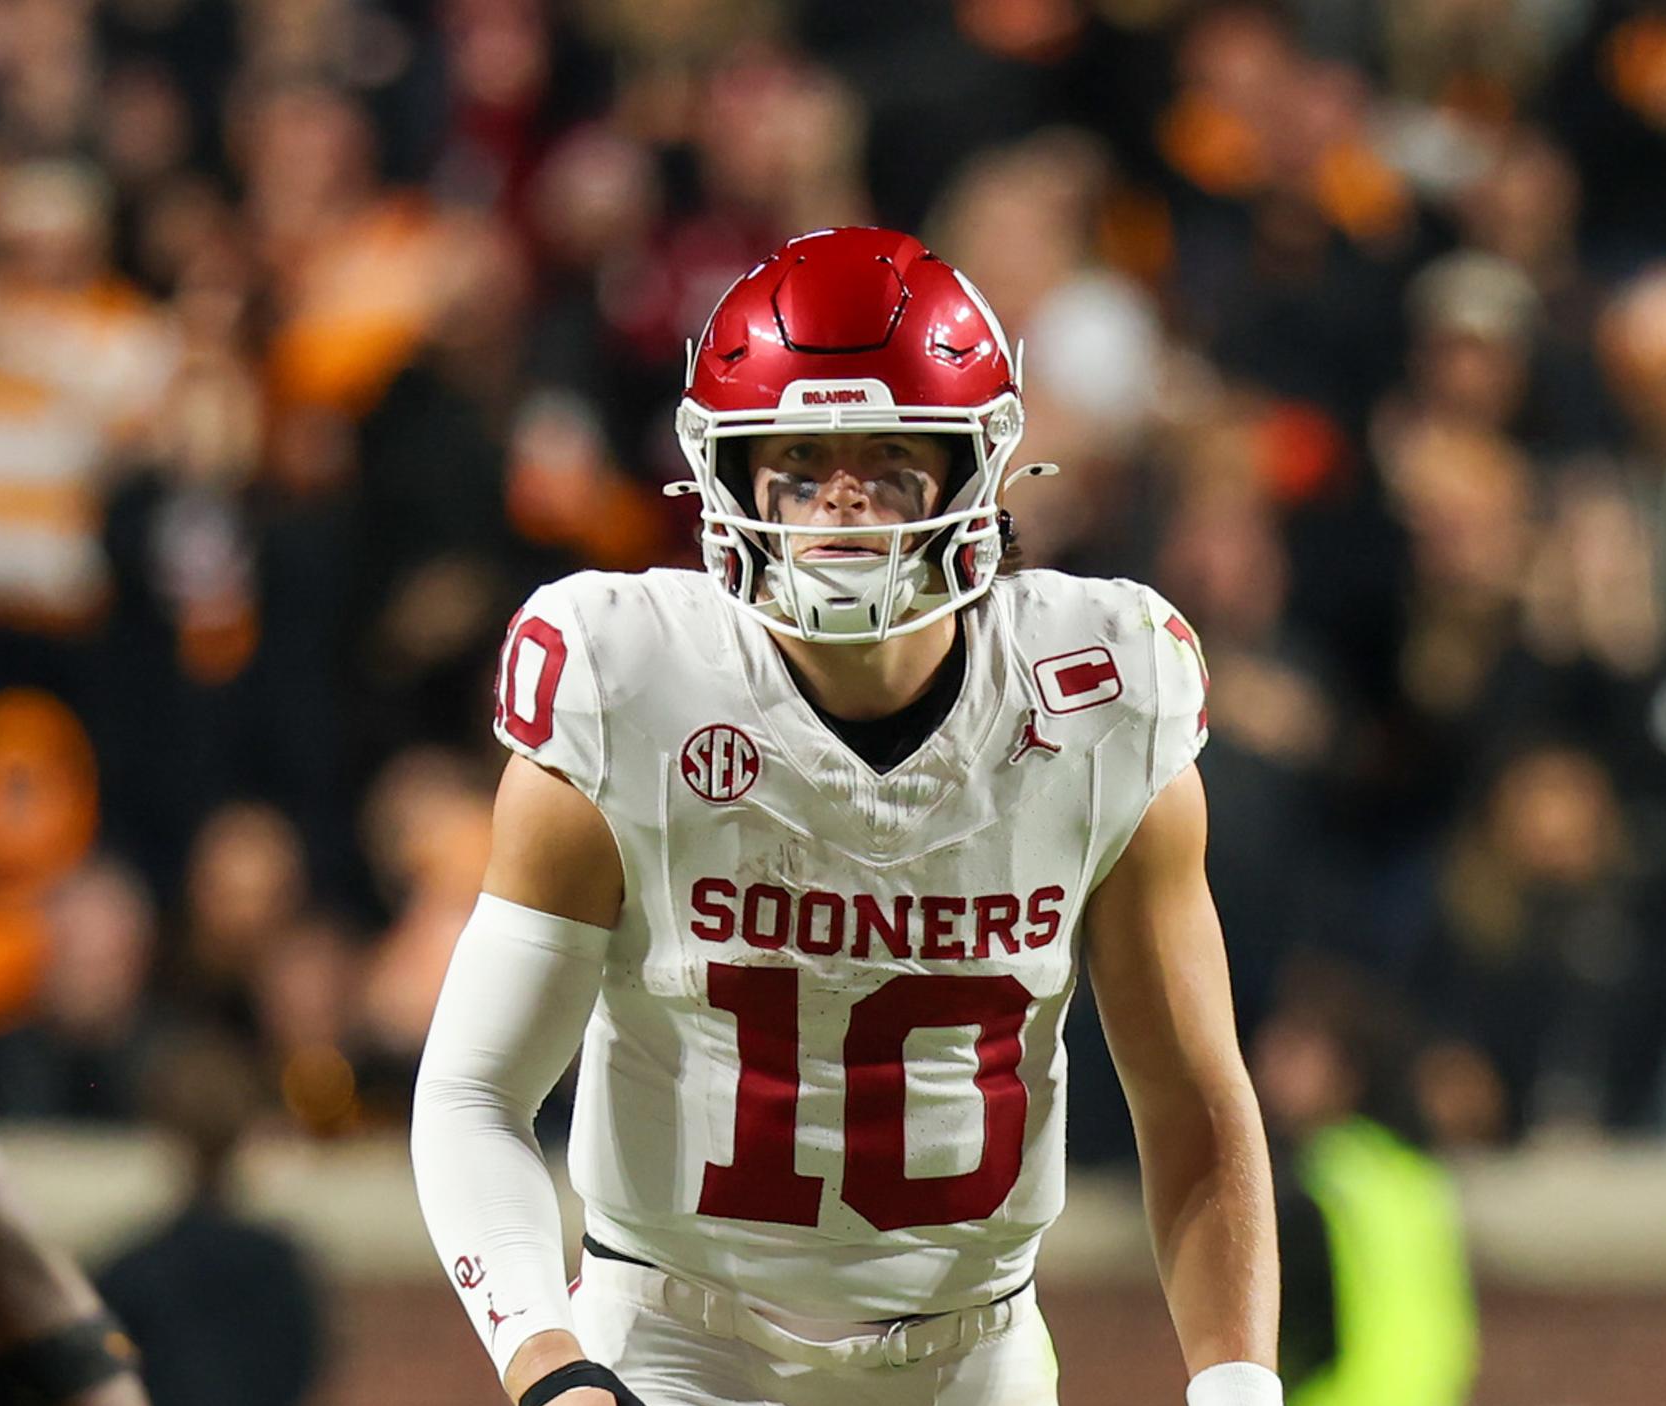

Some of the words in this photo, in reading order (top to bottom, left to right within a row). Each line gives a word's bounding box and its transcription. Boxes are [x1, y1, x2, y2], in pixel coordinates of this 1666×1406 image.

[802, 389, 868, 405] OKLAHOMA
[685, 727, 754, 800] SEC
[690, 876, 1066, 960] SOONERS
[696, 961, 1037, 1232] 10
